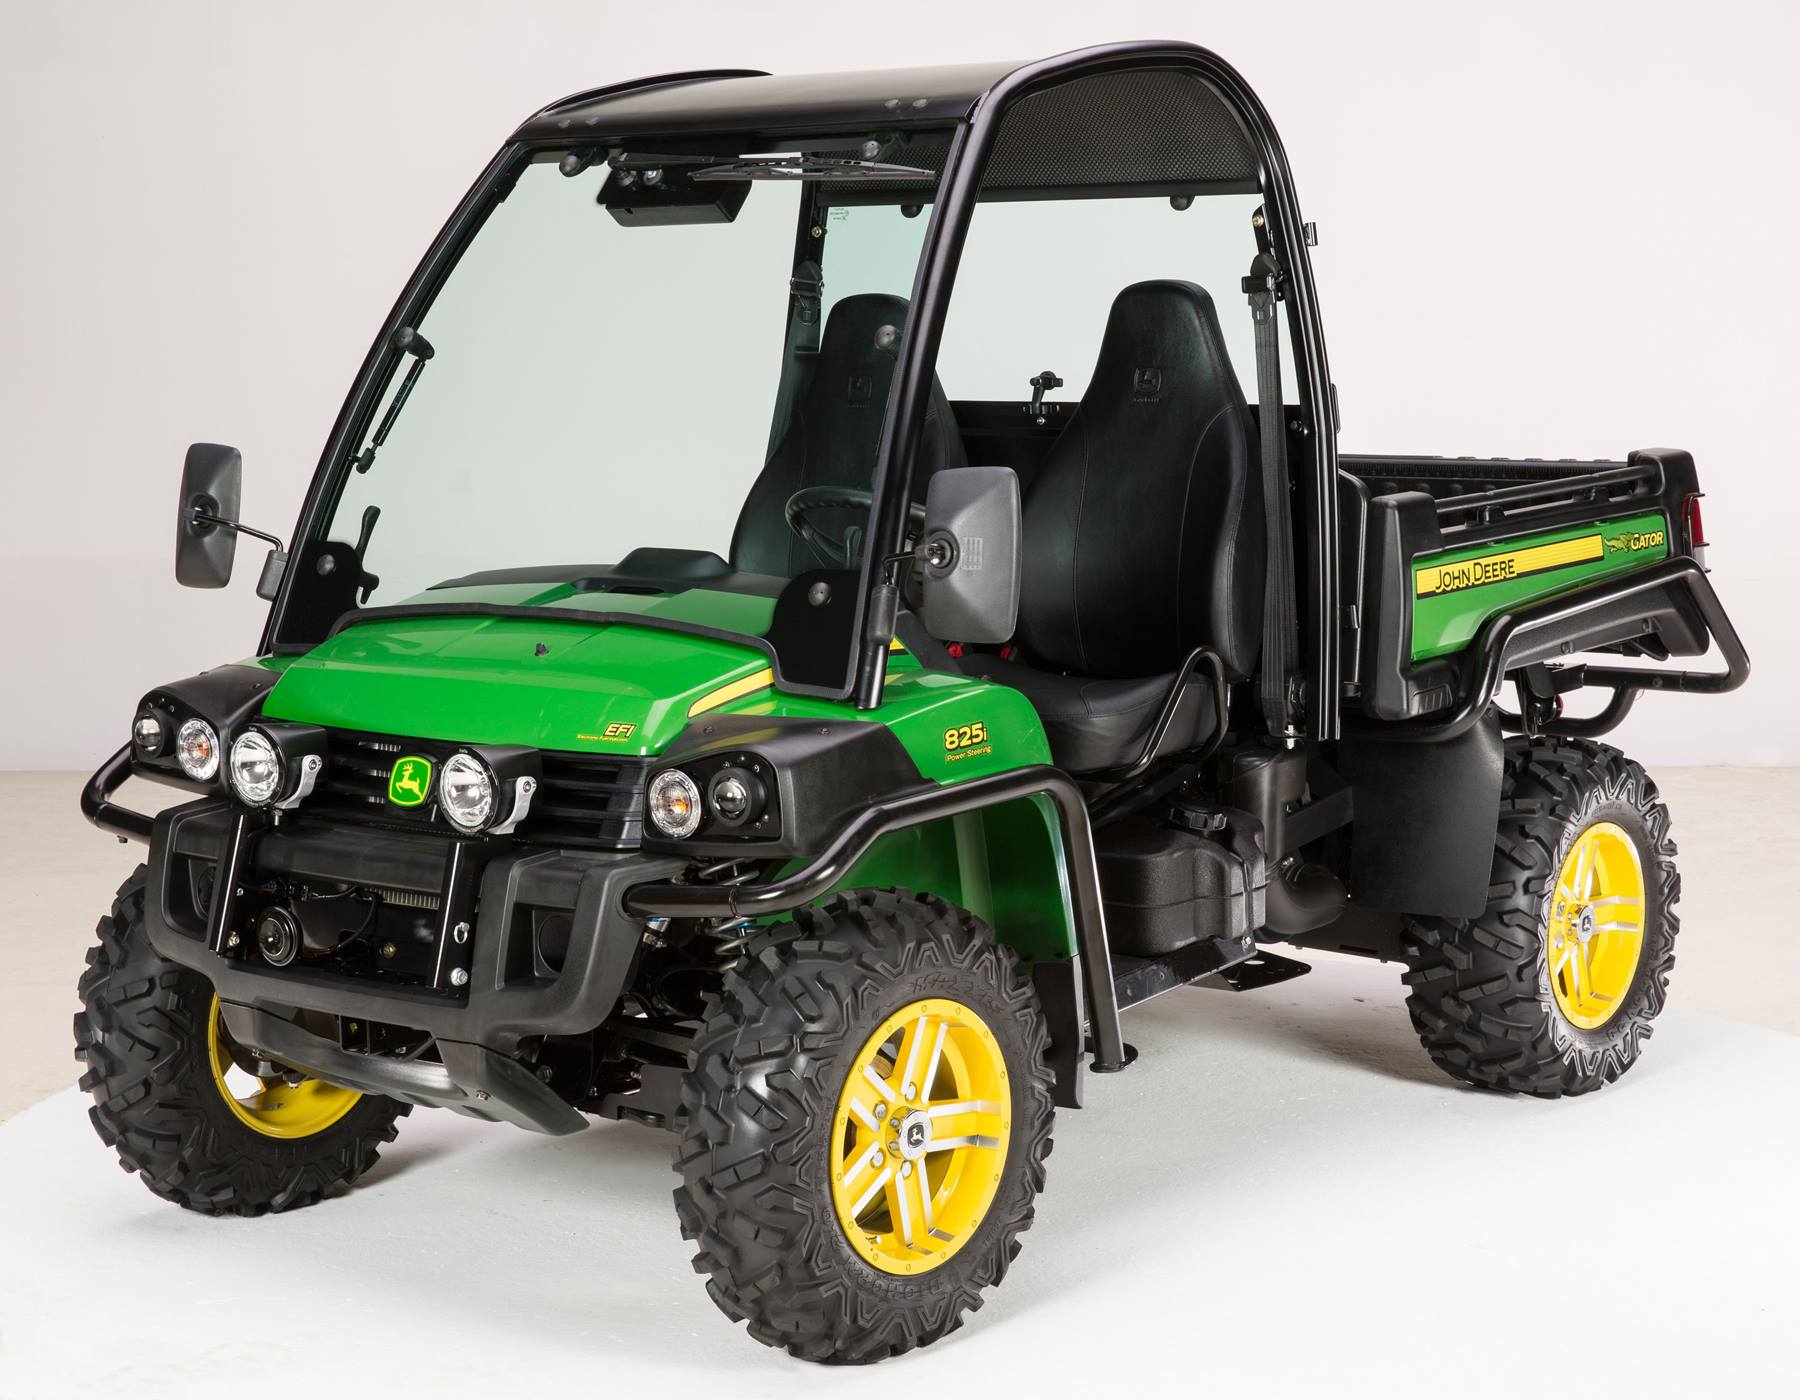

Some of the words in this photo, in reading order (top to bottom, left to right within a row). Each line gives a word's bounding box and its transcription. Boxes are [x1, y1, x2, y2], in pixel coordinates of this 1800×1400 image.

[1630, 530, 1664, 551] GATOR
[1435, 568, 1471, 590] JOHN
[1473, 559, 1516, 582] DEERE
[603, 722, 637, 738] EFI
[944, 720, 988, 752] 825i
[946, 752, 966, 763] Power
